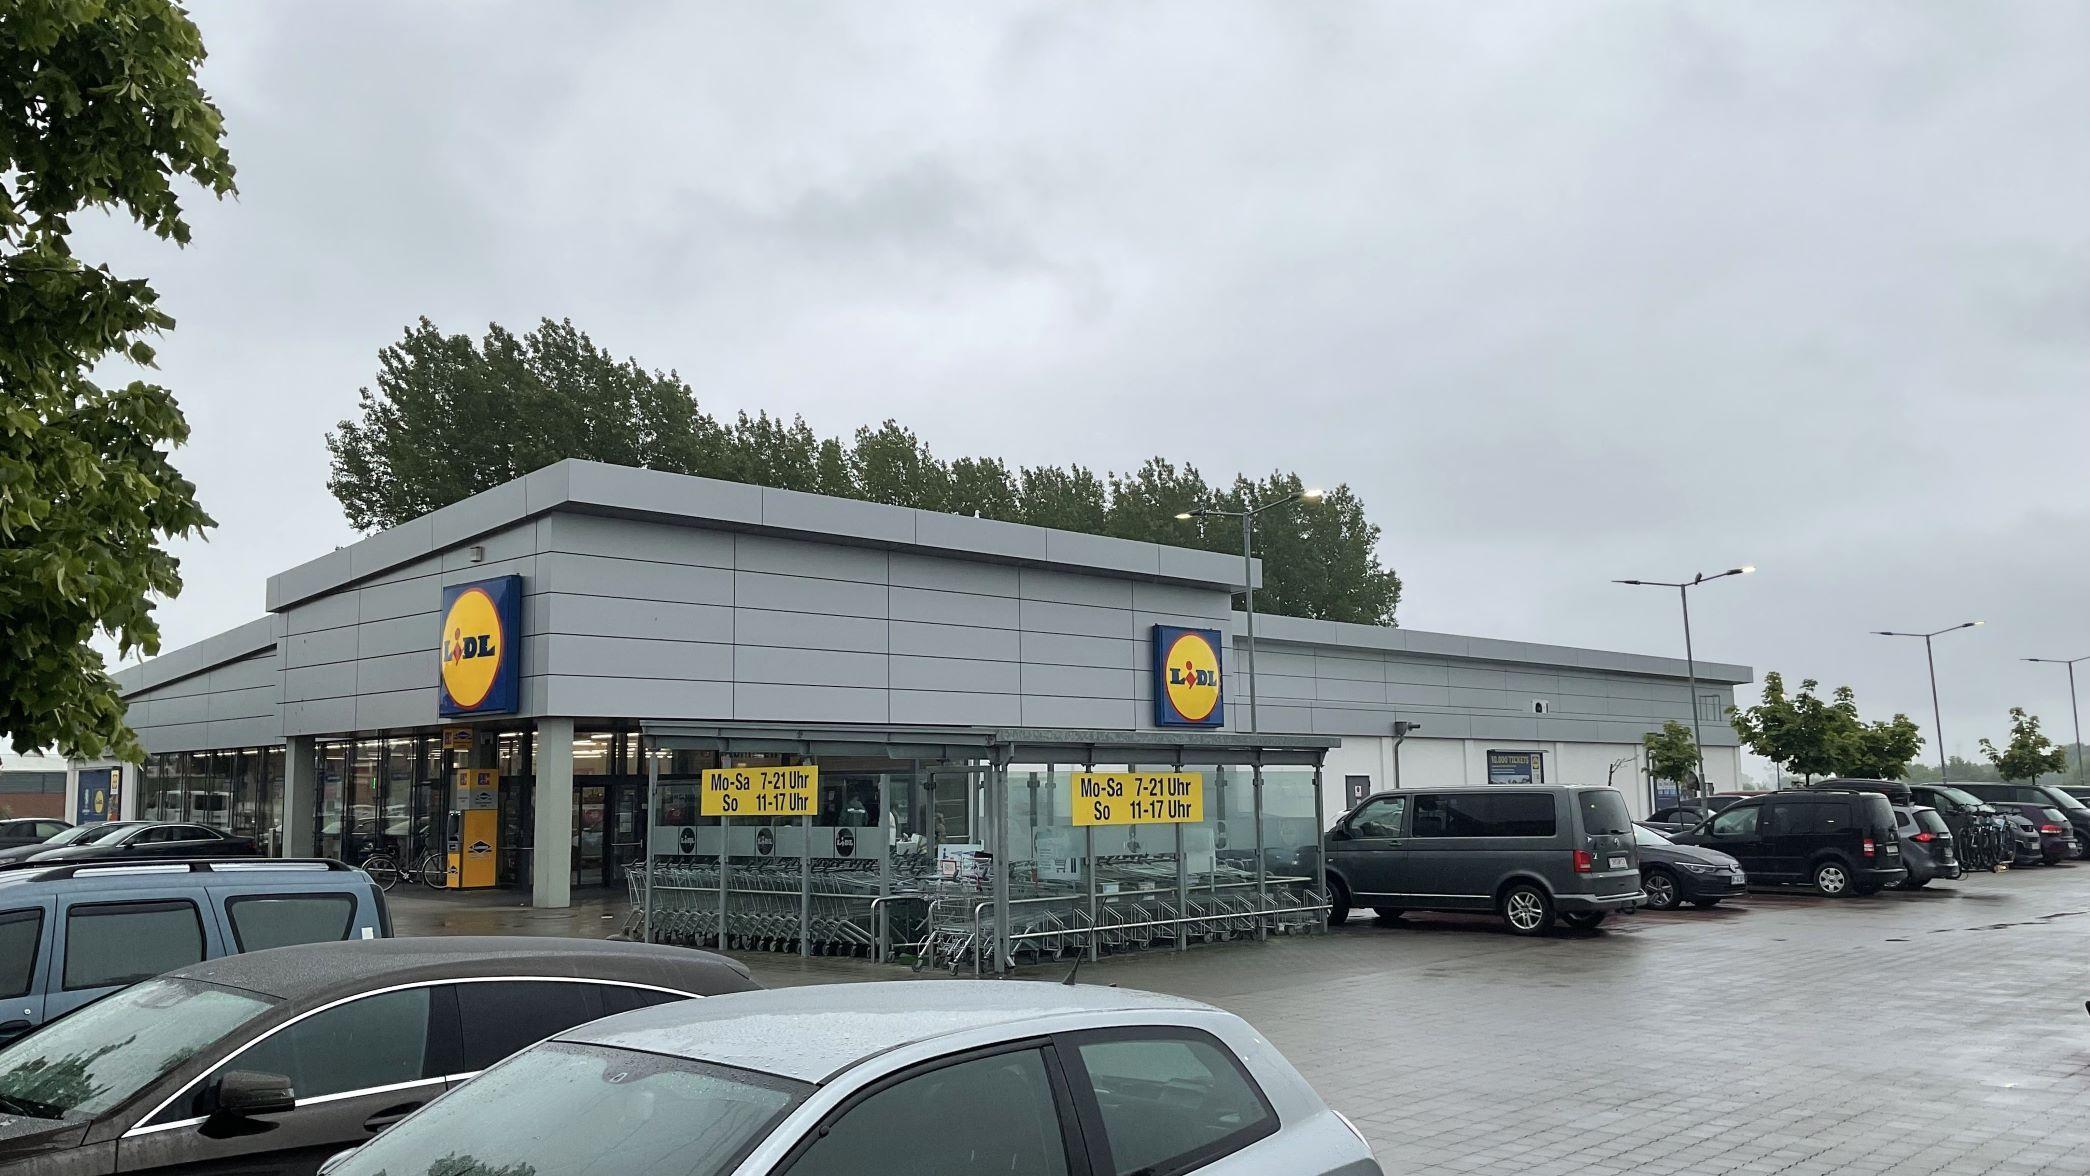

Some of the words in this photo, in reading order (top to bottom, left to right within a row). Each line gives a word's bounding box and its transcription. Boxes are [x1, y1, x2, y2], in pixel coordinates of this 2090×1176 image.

[1509, 755, 1529, 764] TICKETS
[711, 772, 750, 791] Mo-Sa
[761, 771, 786, 790] 7-21
[789, 770, 809, 789] Uhr
[1081, 777, 1123, 798] Mo-Sa
[1134, 777, 1164, 797] 7-21
[1167, 777, 1192, 796] Uhr
[722, 793, 739, 812] So
[756, 792, 786, 811] 11-17
[789, 792, 809, 811] Uhr
[1094, 801, 1111, 821] So
[1129, 800, 1164, 819] 11-17
[1167, 799, 1192, 818] Uhr
